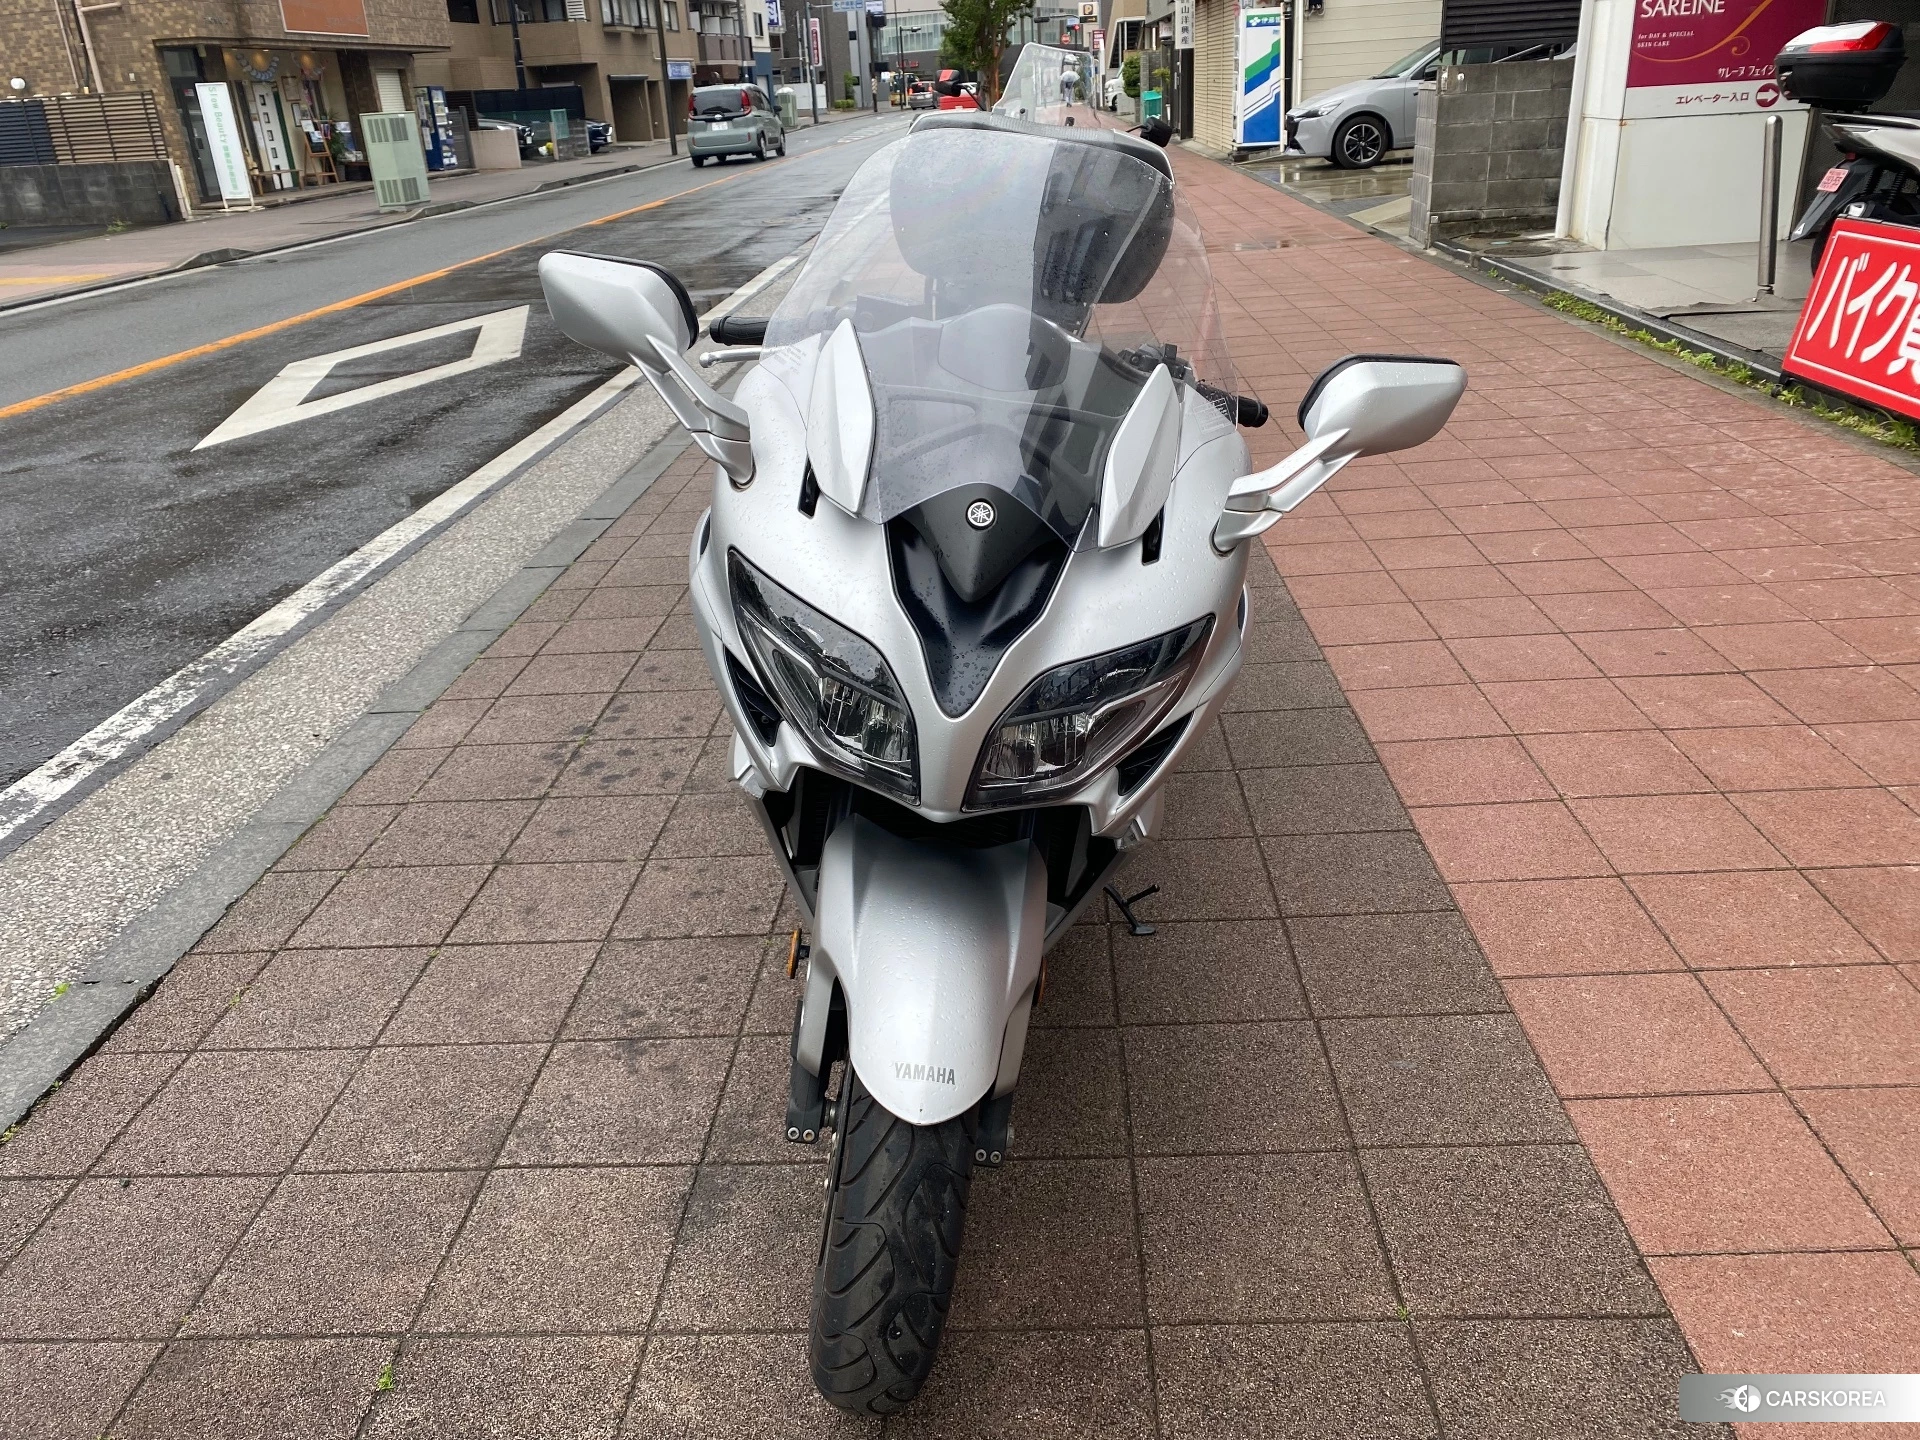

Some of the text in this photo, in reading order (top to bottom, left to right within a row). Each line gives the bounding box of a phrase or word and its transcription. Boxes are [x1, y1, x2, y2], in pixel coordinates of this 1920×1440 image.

[1640, 0, 1726, 18] SAREINE
[1668, 30, 1695, 38] SPECIAL
[1718, 66, 1746, 78] サレーヌ
[1675, 91, 1750, 105] エレベーター入口
[208, 86, 228, 144] Slow Beauty
[894, 1062, 956, 1085] YAMAHA
